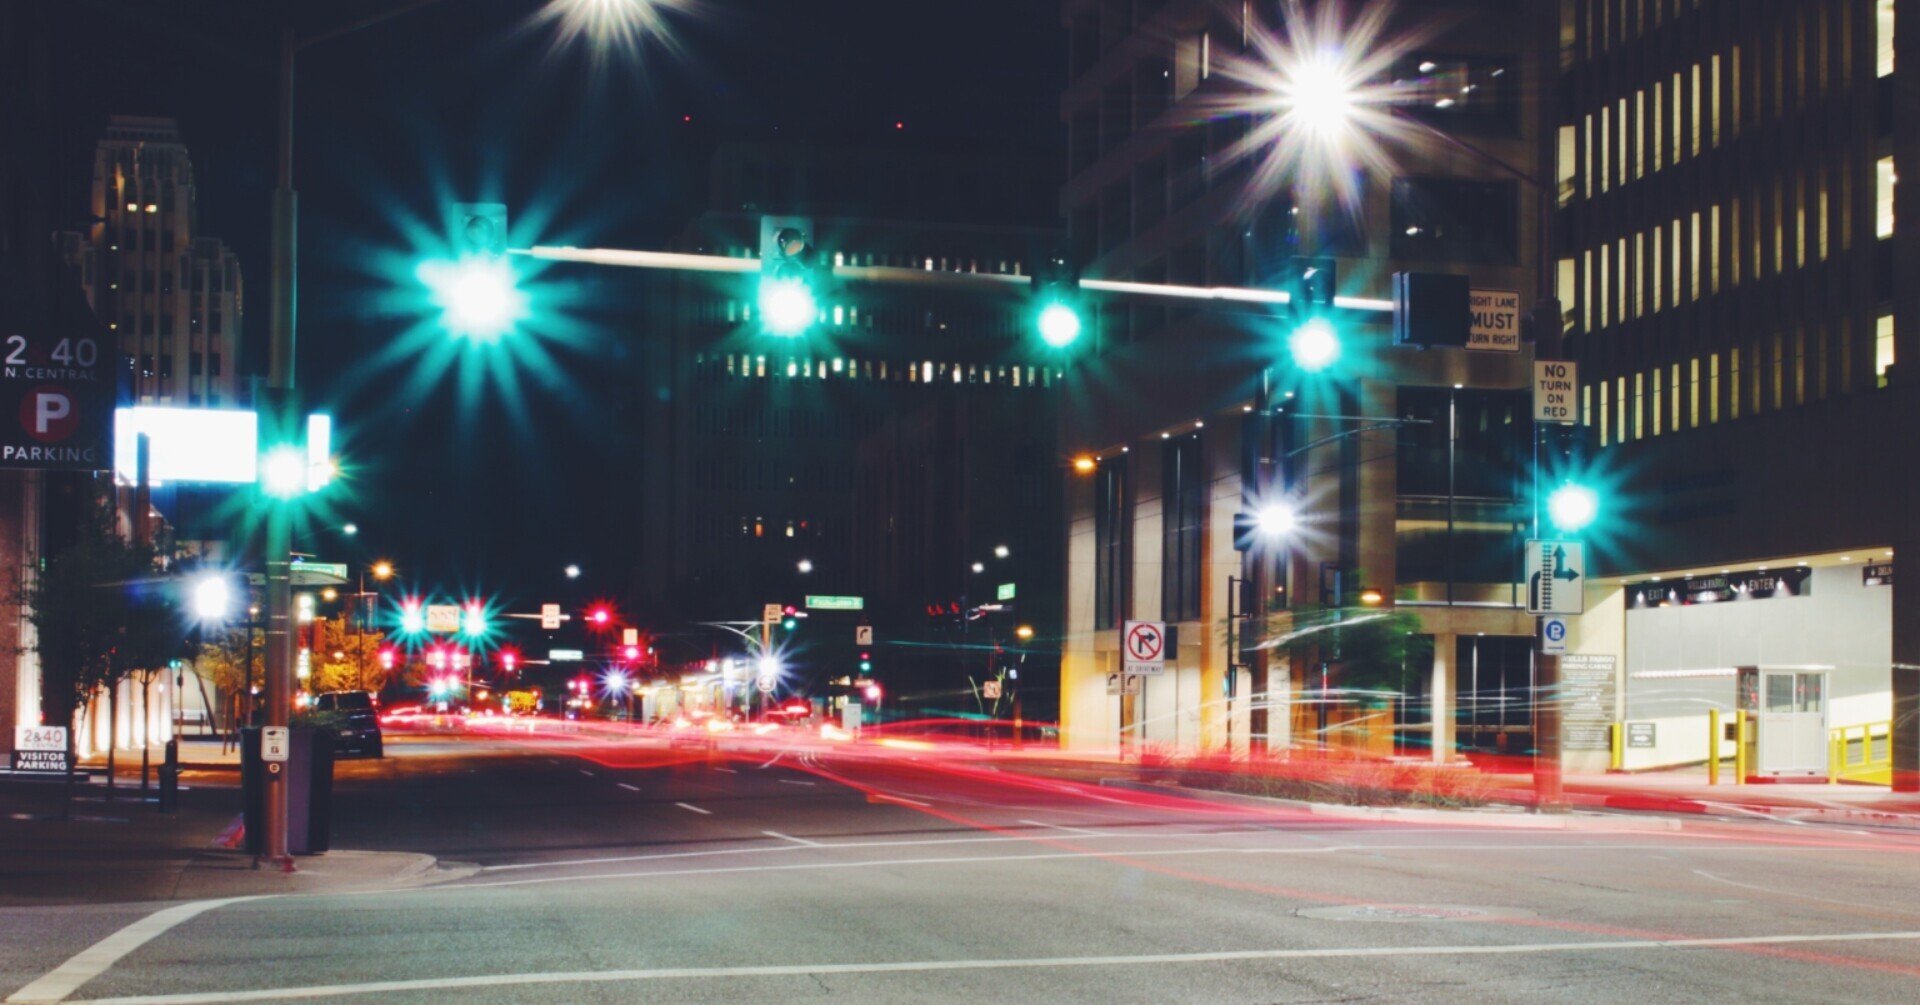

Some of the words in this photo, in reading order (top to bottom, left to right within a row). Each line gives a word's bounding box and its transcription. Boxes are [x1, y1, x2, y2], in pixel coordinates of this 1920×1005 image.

[1495, 297, 1516, 309] LANE
[1470, 311, 1514, 330] MUST
[1492, 334, 1516, 345] RIGHT
[1544, 363, 1566, 378] NO
[1540, 380, 1571, 391] TURN
[1547, 393, 1564, 403] ON
[36, 393, 71, 433] P
[1543, 406, 1567, 417] RED
[3, 445, 96, 462] PARKING
[1749, 578, 1775, 591] ENTER
[1648, 588, 1664, 600] EXIT
[20, 752, 65, 761] VISITOR
[17, 760, 67, 770] PARKING
